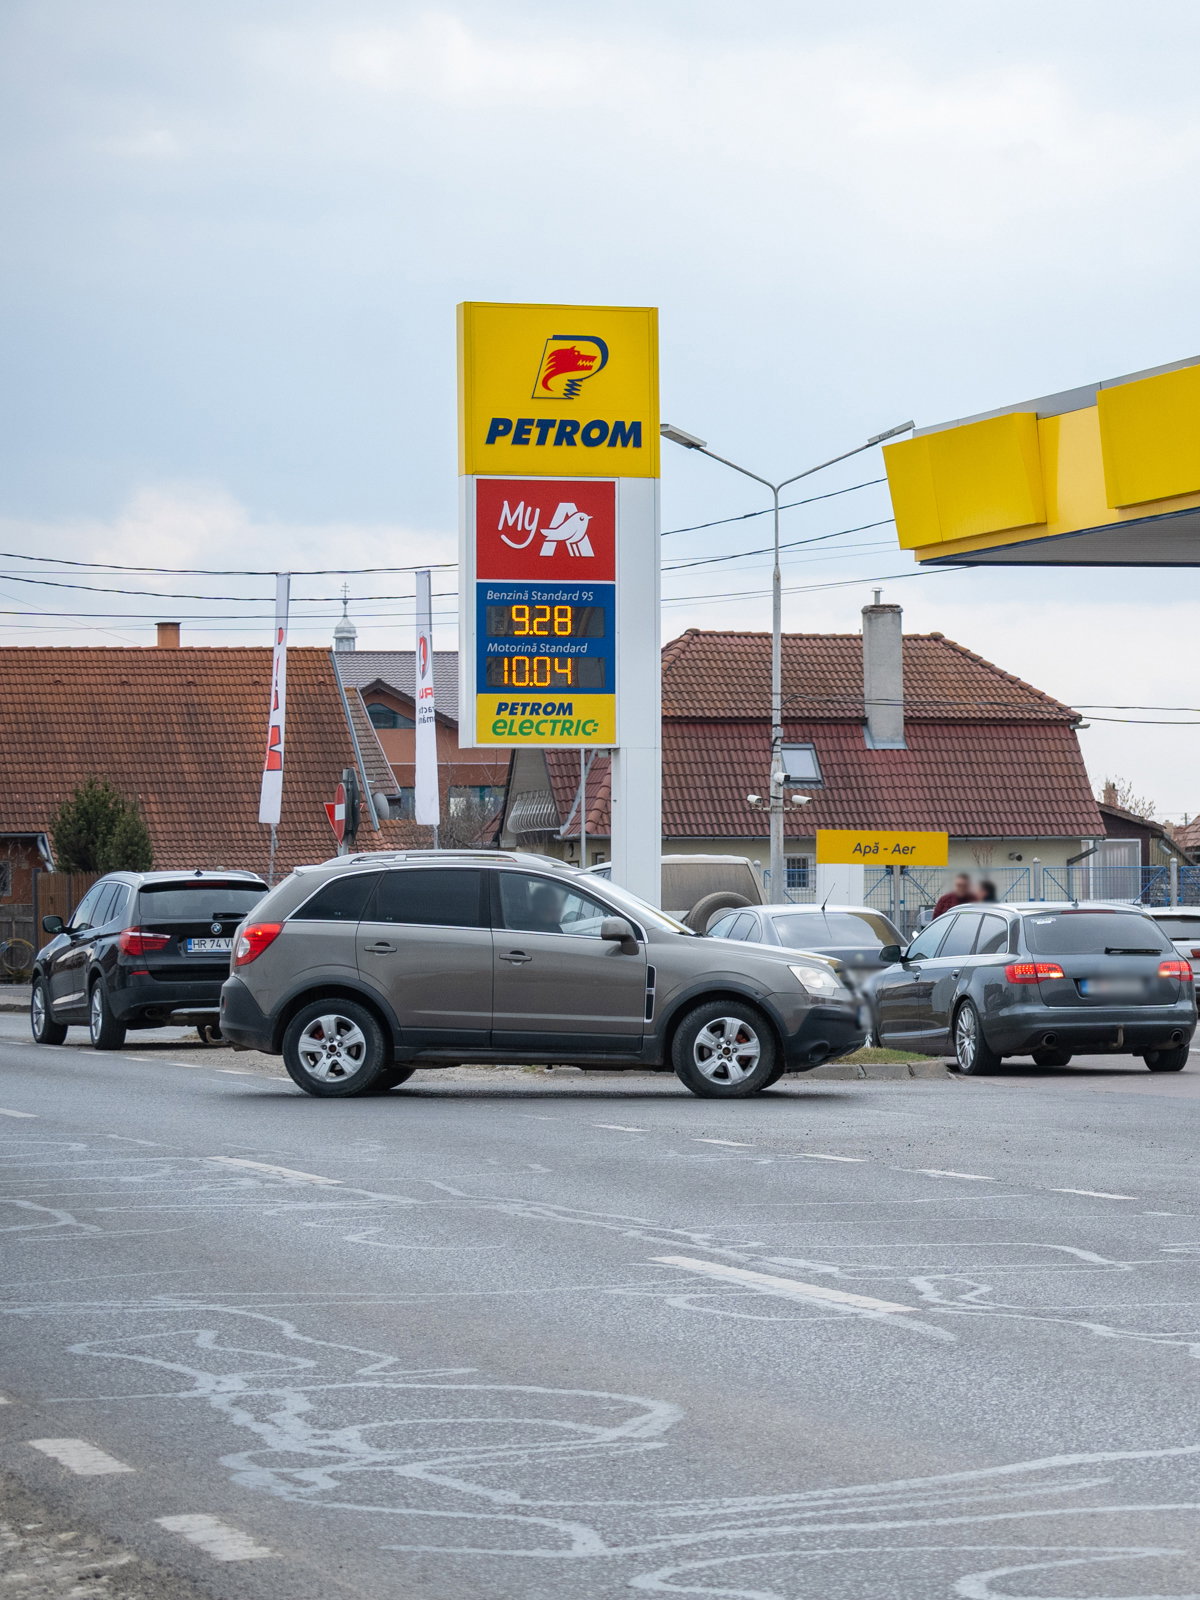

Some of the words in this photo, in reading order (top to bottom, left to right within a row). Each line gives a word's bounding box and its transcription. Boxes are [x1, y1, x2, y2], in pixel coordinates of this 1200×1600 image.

[485, 417, 642, 448] PETROM
[497, 500, 540, 549] My
[486, 590, 529, 600] Benzină
[531, 590, 579, 601] Standard
[581, 591, 594, 601] 95
[511, 605, 572, 636] 9.28
[487, 642, 537, 653] Motorină
[539, 643, 588, 653] Standard
[503, 655, 572, 687] 10.04
[495, 702, 574, 716] PETROM
[852, 842, 880, 857] Apă
[891, 843, 916, 855] Aer
[209, 939, 222, 949] 74
